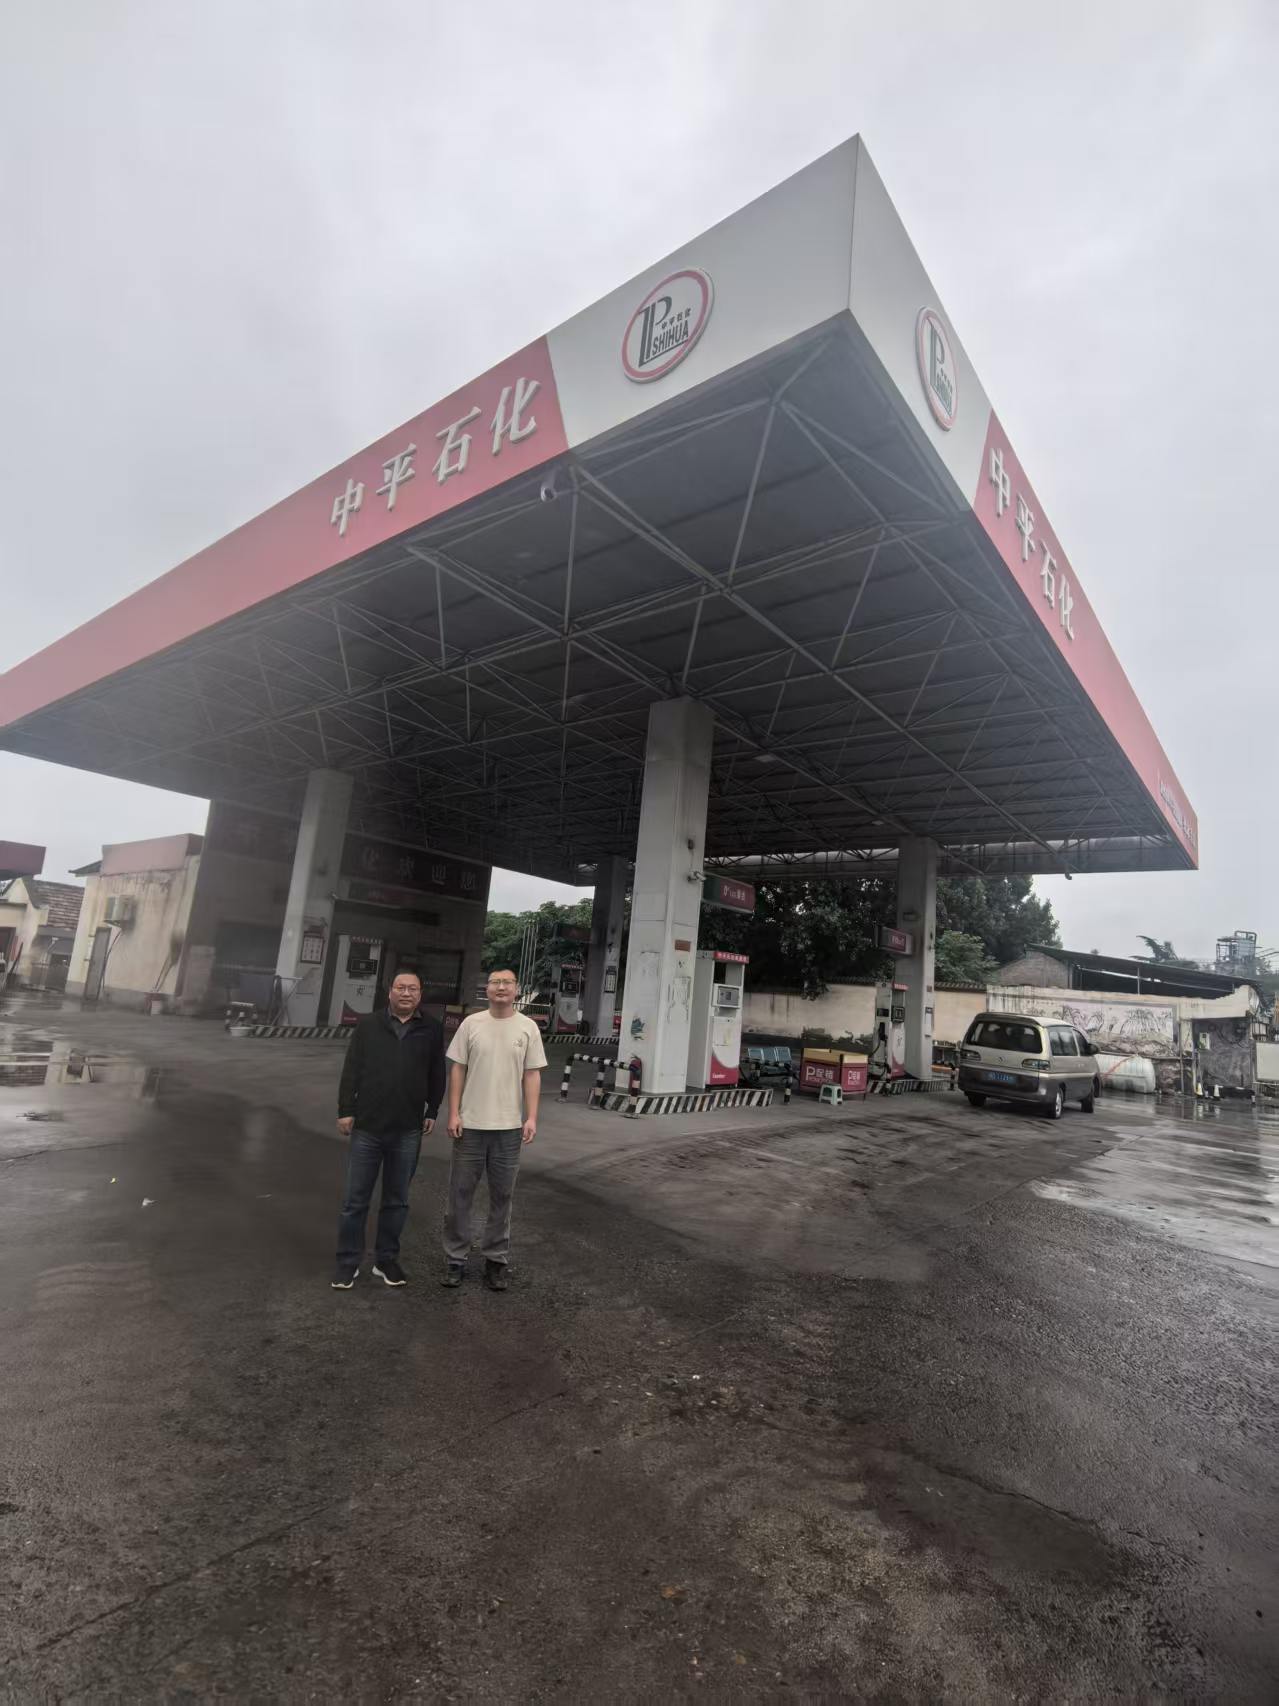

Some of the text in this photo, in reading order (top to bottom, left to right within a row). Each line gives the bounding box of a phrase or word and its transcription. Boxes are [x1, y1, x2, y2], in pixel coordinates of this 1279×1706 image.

[652, 319, 689, 357] SHIHUA
[331, 376, 542, 538] 中平石化
[988, 447, 1075, 641] 中平石化
